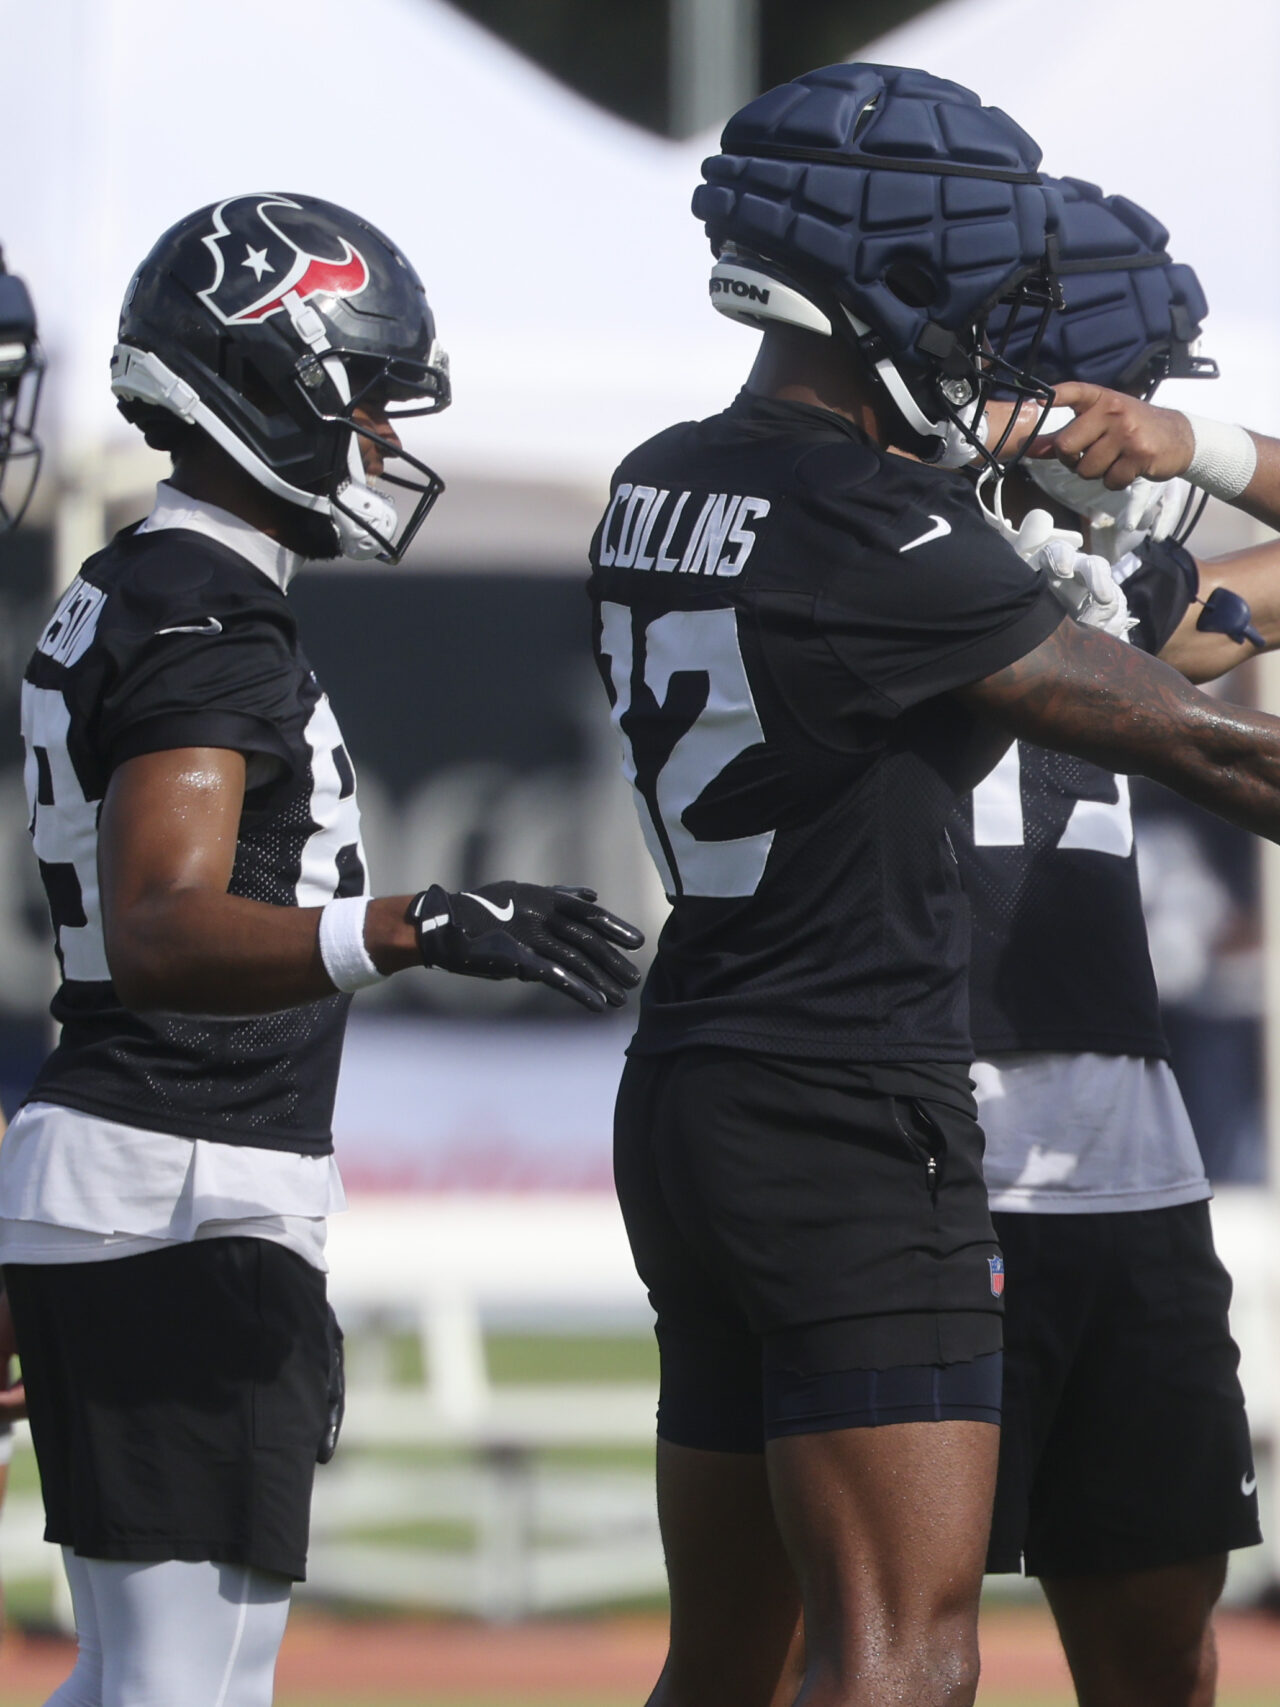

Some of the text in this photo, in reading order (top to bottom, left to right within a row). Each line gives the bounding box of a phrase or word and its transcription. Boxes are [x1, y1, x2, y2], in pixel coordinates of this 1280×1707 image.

[599, 483, 771, 577] COLLINS
[36, 573, 109, 669] SON
[600, 600, 777, 898] 12
